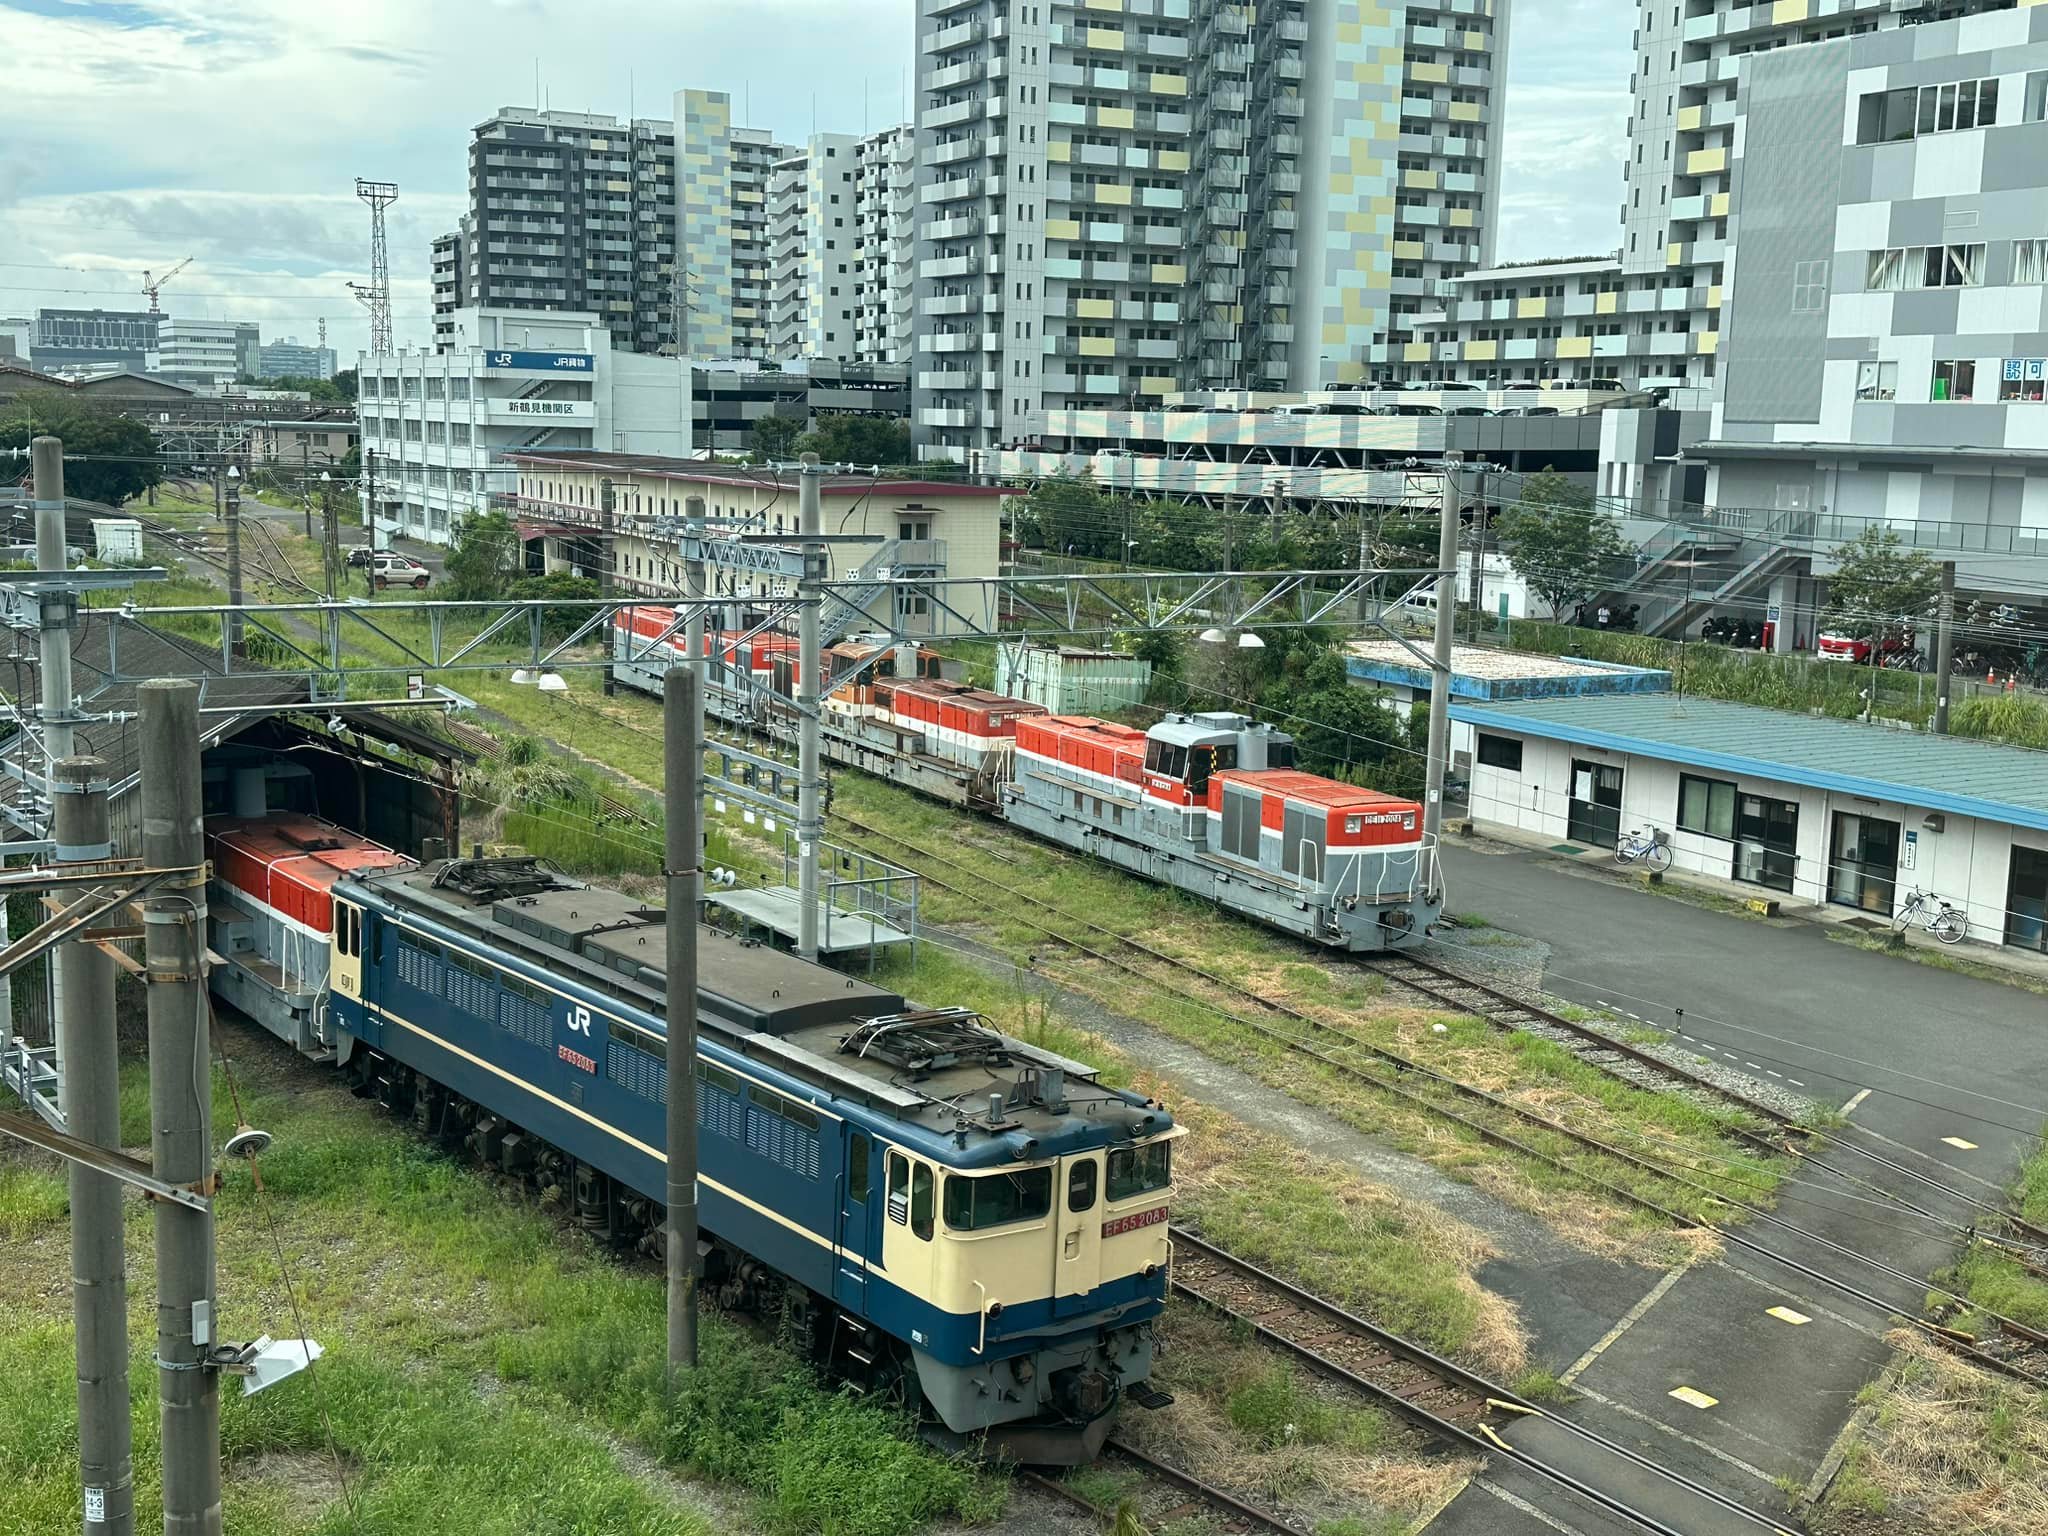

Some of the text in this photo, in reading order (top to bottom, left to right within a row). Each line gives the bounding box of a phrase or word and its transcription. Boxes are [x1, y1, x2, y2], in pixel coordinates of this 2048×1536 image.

[495, 353, 512, 364] JR
[508, 402, 574, 414] 新鶴見機関区
[567, 1006, 590, 1037] JR
[1105, 1207, 1167, 1236] EF65 2083
